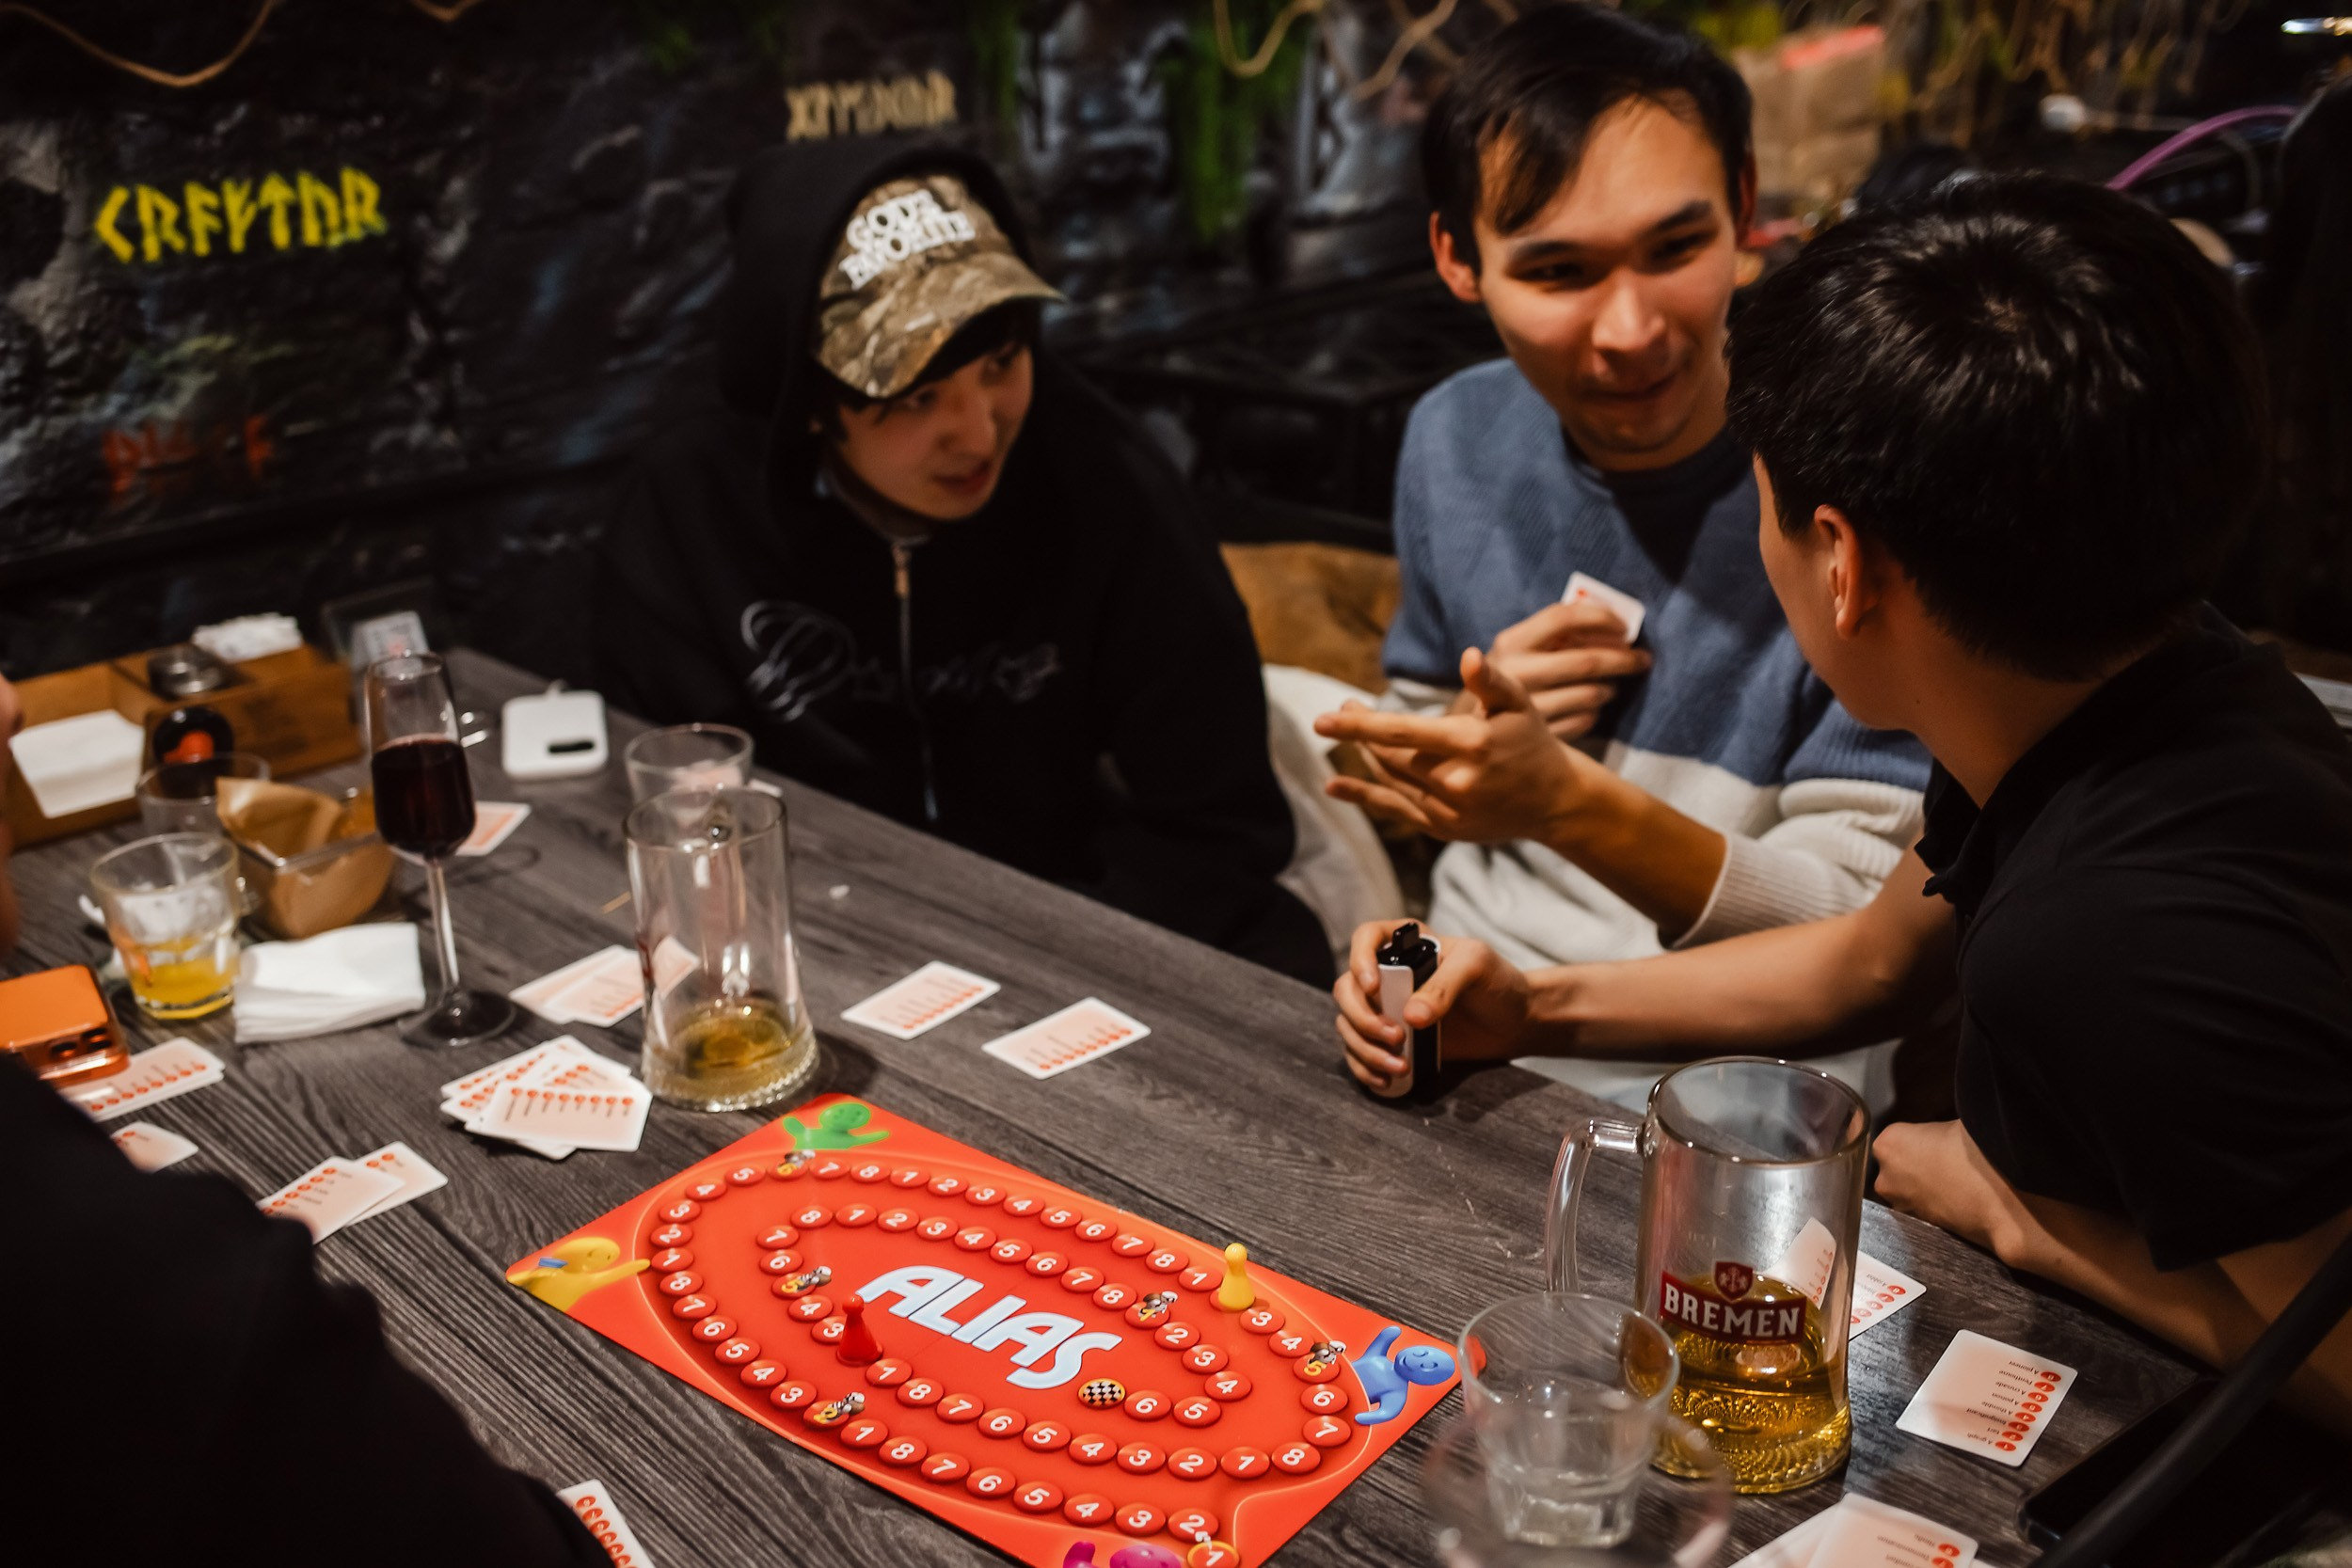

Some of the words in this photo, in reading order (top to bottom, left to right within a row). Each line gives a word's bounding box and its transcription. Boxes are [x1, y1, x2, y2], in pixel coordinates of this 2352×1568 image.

[733, 1167, 755, 1181] 5
[777, 1163, 798, 1175] 6
[818, 1162, 840, 1174] 7
[859, 1164, 880, 1179] 8
[902, 1171, 919, 1183] 1
[936, 1178, 959, 1192] 2
[696, 1183, 716, 1196] 4
[975, 1187, 996, 1201] 3
[670, 1203, 691, 1218] 3
[1012, 1199, 1033, 1212] 4
[800, 1209, 822, 1224] 8
[849, 1209, 866, 1221] 1
[885, 1212, 908, 1227] 2
[1049, 1210, 1072, 1224] 5
[659, 1227, 682, 1243] 2
[766, 1228, 788, 1243] 7
[926, 1221, 947, 1236] 3
[1086, 1223, 1106, 1237] 6
[963, 1232, 985, 1245] 4
[1121, 1235, 1144, 1250] 7
[997, 1242, 1021, 1258] 5
[663, 1253, 681, 1267] 1
[770, 1255, 791, 1270] 6
[1036, 1257, 1057, 1272] 6
[1154, 1253, 1176, 1268] 8
[669, 1275, 691, 1291] 8
[781, 1279, 803, 1293] 5
[1071, 1272, 1094, 1286] 7
[1190, 1273, 1208, 1286] 1
[682, 1298, 707, 1312] 7
[1103, 1289, 1124, 1305] 8
[800, 1302, 822, 1316] 4
[1664, 1282, 1801, 1338] BREMEN
[855, 1265, 1123, 1389] ALIAS
[1251, 1311, 1273, 1327] 3
[703, 1321, 726, 1337] 6
[1165, 1327, 1189, 1344] 2
[725, 1342, 750, 1359] 5
[1279, 1335, 1303, 1351] 4
[1194, 1351, 1216, 1367] 3
[753, 1367, 775, 1382] 4
[879, 1366, 898, 1381] 1
[1304, 1360, 1327, 1376] 5
[1999, 1370, 2033, 1386] Penthouse
[780, 1386, 803, 1403] 3
[908, 1384, 932, 1401] 8
[1216, 1379, 1238, 1394] 4
[1135, 1397, 1158, 1414] 6
[1312, 1390, 1335, 1407] 6
[948, 1399, 973, 1415] 7
[1184, 1402, 1209, 1419] 5
[990, 1415, 1013, 1432] 6
[1315, 1422, 1339, 1438] 7
[855, 1426, 875, 1441] 1
[1032, 1427, 1058, 1444] 5
[890, 1443, 915, 1460] 8
[1081, 1442, 1104, 1458] 4
[1128, 1449, 1152, 1466] 3
[1281, 1448, 1306, 1466] 8
[931, 1458, 957, 1475] 7
[1178, 1453, 1204, 1473] 2
[1238, 1455, 1255, 1471] 1
[977, 1475, 1002, 1492] 6
[1024, 1487, 1051, 1506] 5
[1075, 1502, 1100, 1518] 4
[1128, 1510, 1152, 1528] 3
[1179, 1513, 1205, 1534] 2
[1206, 1550, 1224, 1567] 1
